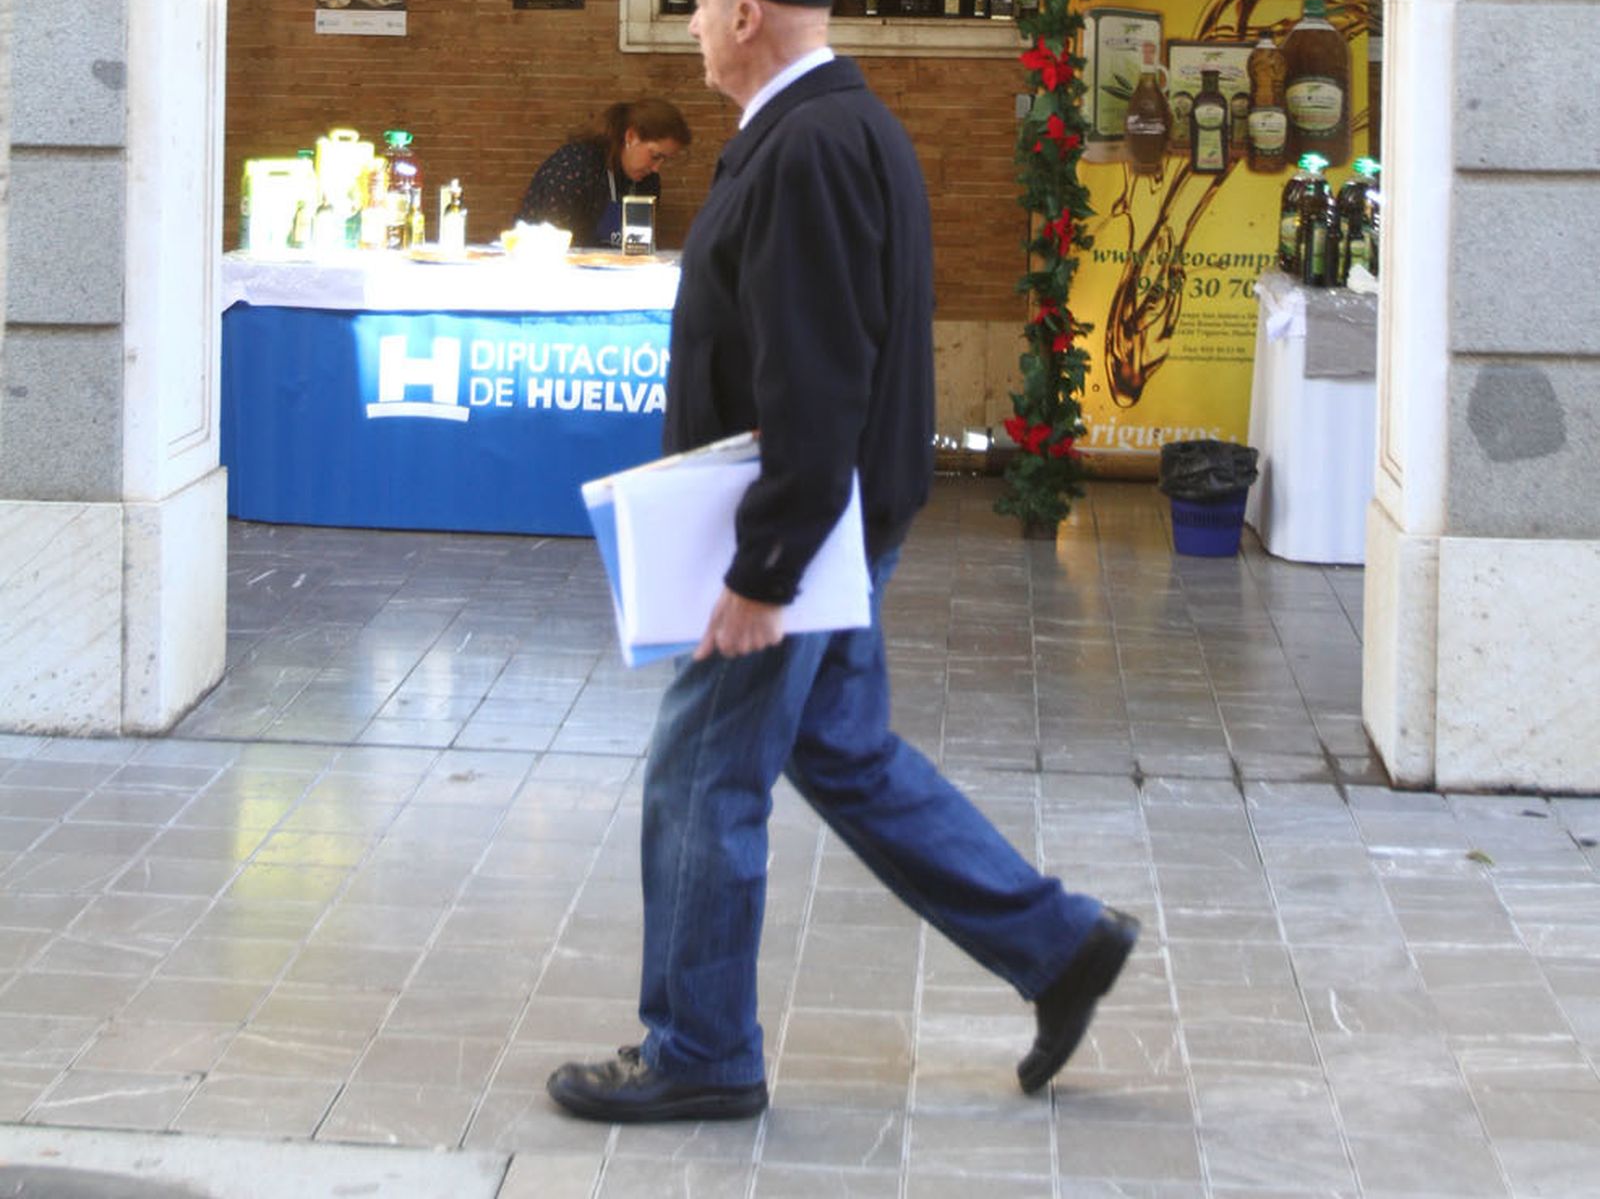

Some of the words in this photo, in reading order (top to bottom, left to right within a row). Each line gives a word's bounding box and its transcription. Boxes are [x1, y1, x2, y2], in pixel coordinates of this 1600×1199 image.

[1189, 278, 1220, 298] 30
[470, 377, 514, 407] DE
[527, 377, 667, 414] HUELVA
